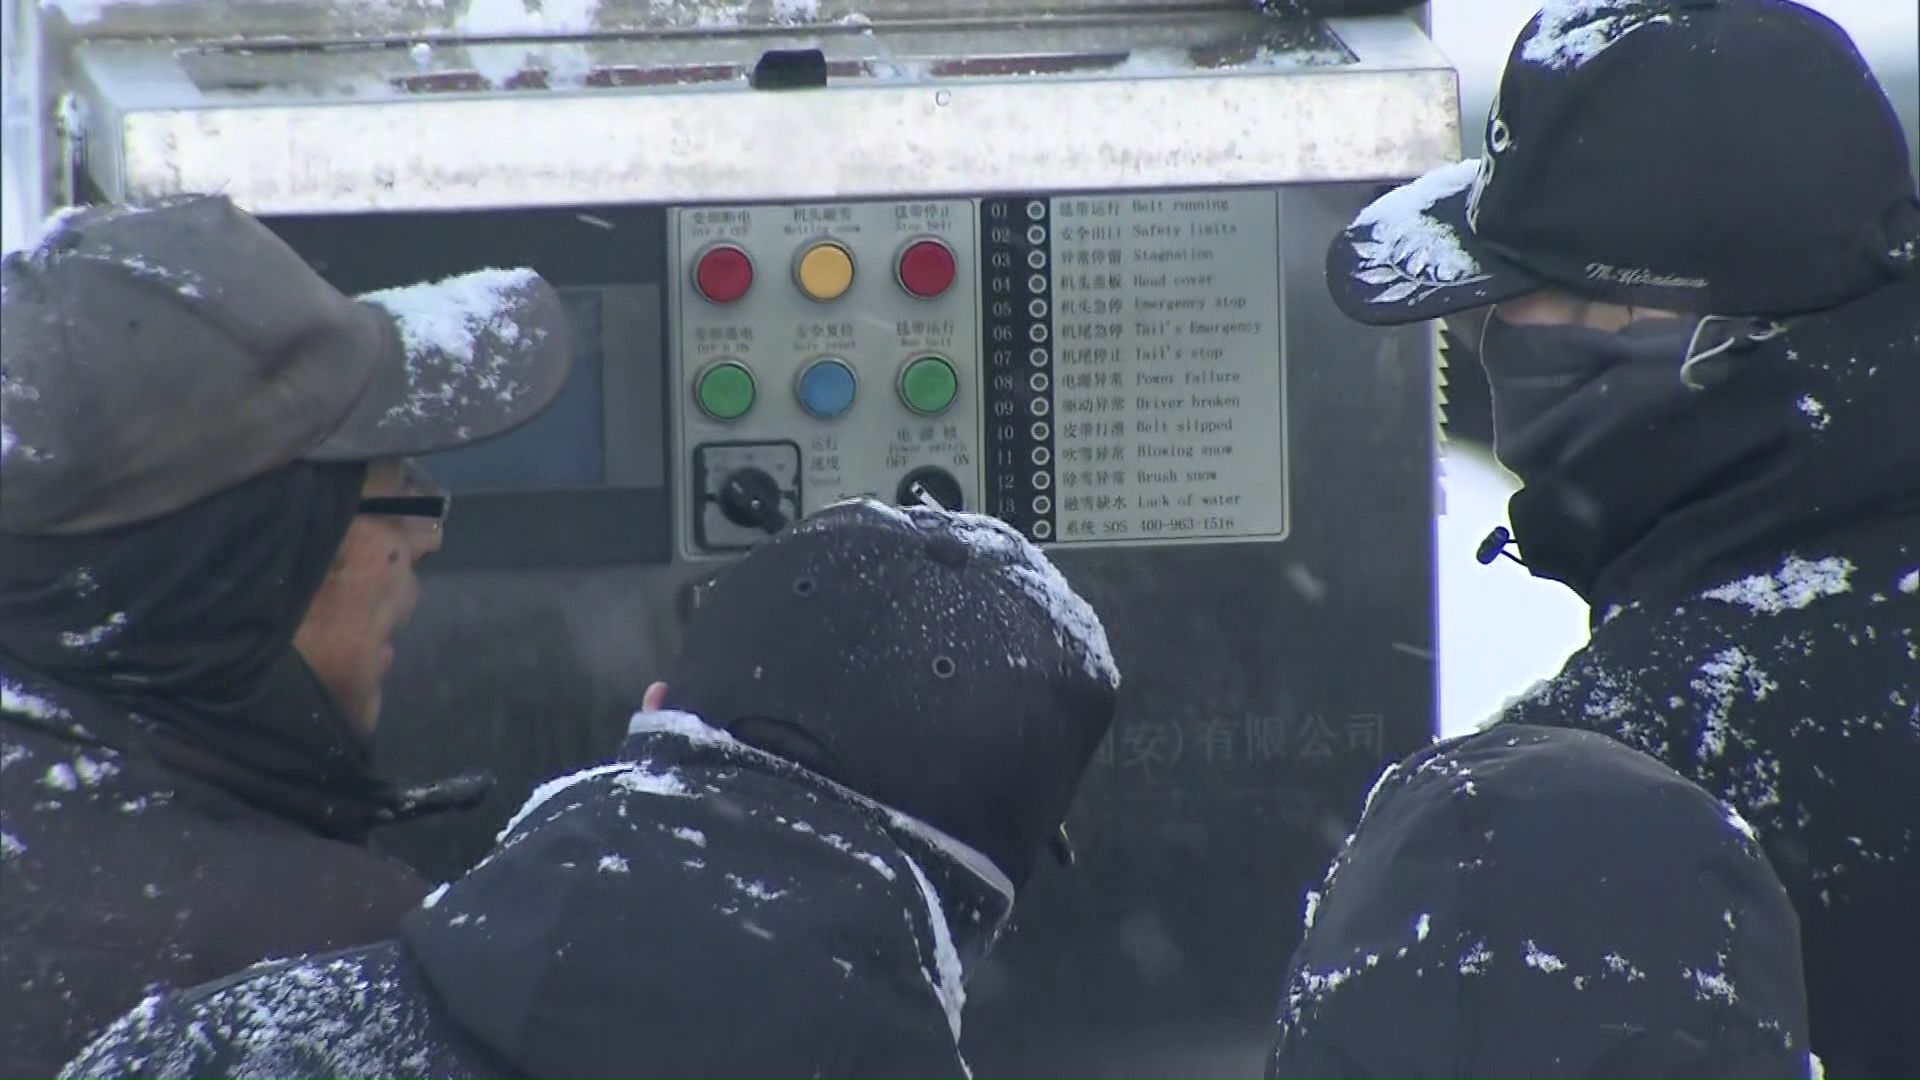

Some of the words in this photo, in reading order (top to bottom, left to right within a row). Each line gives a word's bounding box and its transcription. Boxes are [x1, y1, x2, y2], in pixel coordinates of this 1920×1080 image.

[991, 204, 1009, 217] 01
[1132, 199, 1162, 213] Belt
[1173, 199, 1229, 213] running
[991, 229, 1011, 242] 02
[1132, 225, 1181, 238] Safety
[1190, 223, 1237, 236] limits
[992, 254, 1011, 267] 03
[1133, 249, 1214, 263] Stagnation
[993, 279, 1011, 291] 04
[1133, 274, 1167, 288] Head
[1173, 275, 1214, 287] cover
[993, 303, 1012, 316] 05
[1134, 298, 1205, 313] Emergency
[1214, 296, 1246, 310] stop
[993, 328, 1012, 340] 06
[1062, 324, 1123, 340] 机尾急停
[1135, 321, 1182, 336] Tail's
[1189, 321, 1261, 336] Emergency
[994, 352, 1012, 365] 07
[1063, 348, 1121, 364] 机尾停止
[1135, 345, 1182, 360] Tail's
[1190, 347, 1223, 361] stop
[994, 376, 1013, 390] 08
[1136, 373, 1174, 386] Power
[1185, 371, 1240, 384] failure
[995, 401, 1014, 415] 09
[1136, 397, 1183, 410] Driver
[1192, 395, 1240, 408] broken
[997, 426, 1014, 439] 10
[1136, 420, 1168, 433] Belt
[1176, 418, 1232, 433] slipped
[998, 451, 1013, 464] 11
[1137, 445, 1193, 459] Blowing
[1201, 446, 1233, 456] snow
[953, 453, 970, 466] ON
[998, 475, 1015, 488] 12
[1137, 470, 1177, 484] Brush
[1186, 472, 1217, 482] snow
[1137, 495, 1169, 508] Lack
[1177, 495, 1193, 507] of
[1202, 493, 1241, 506] water
[1103, 519, 1129, 534] SOS
